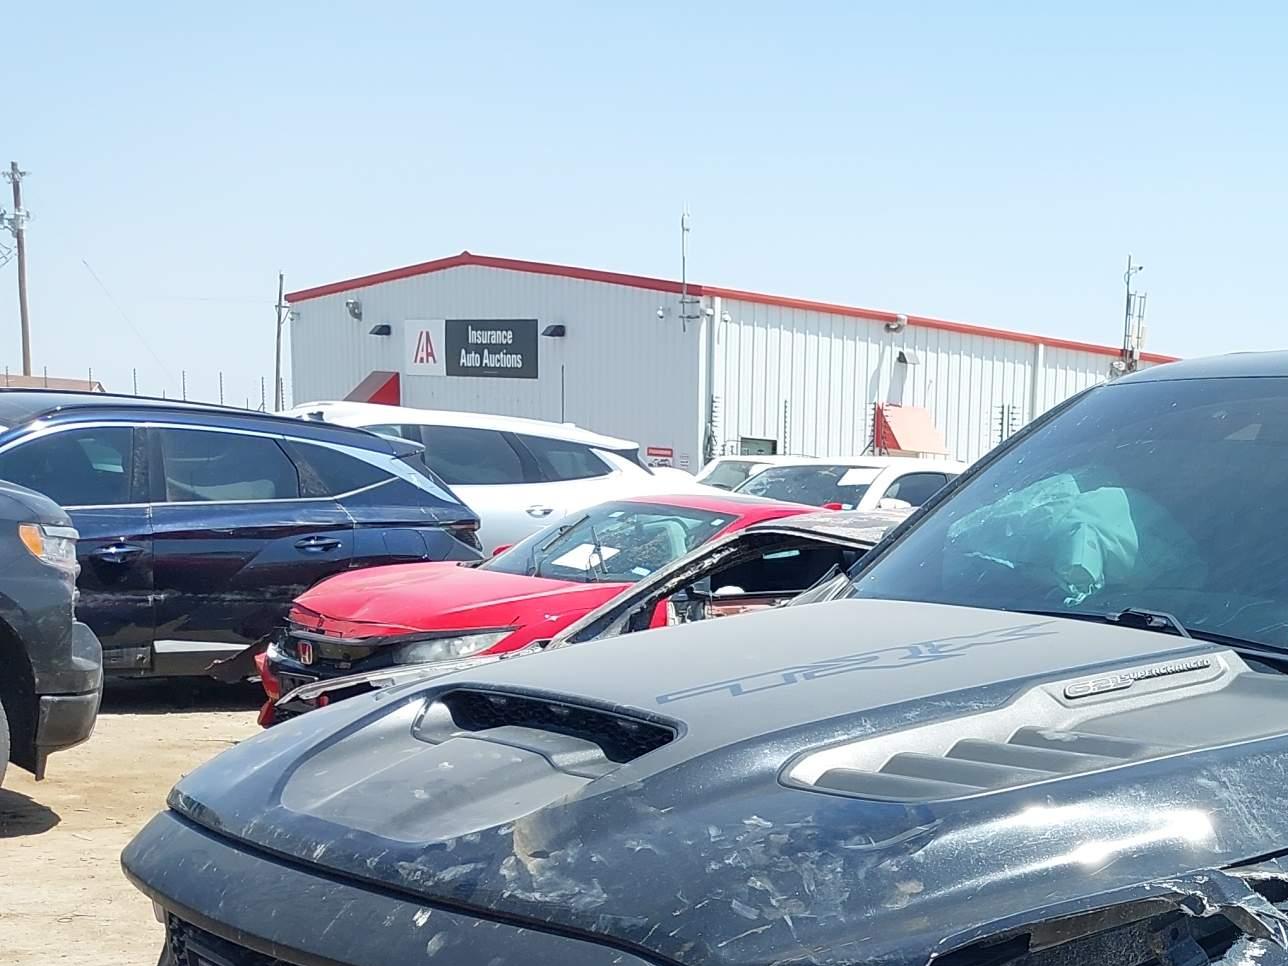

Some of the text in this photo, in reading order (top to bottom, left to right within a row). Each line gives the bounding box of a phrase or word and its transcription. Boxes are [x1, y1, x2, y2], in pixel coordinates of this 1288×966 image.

[468, 325, 513, 344] Insurance
[459, 348, 523, 369] Auto Auctions
[656, 620, 1060, 704] TRX
[1119, 658, 1211, 681] SUPERCHARGED
